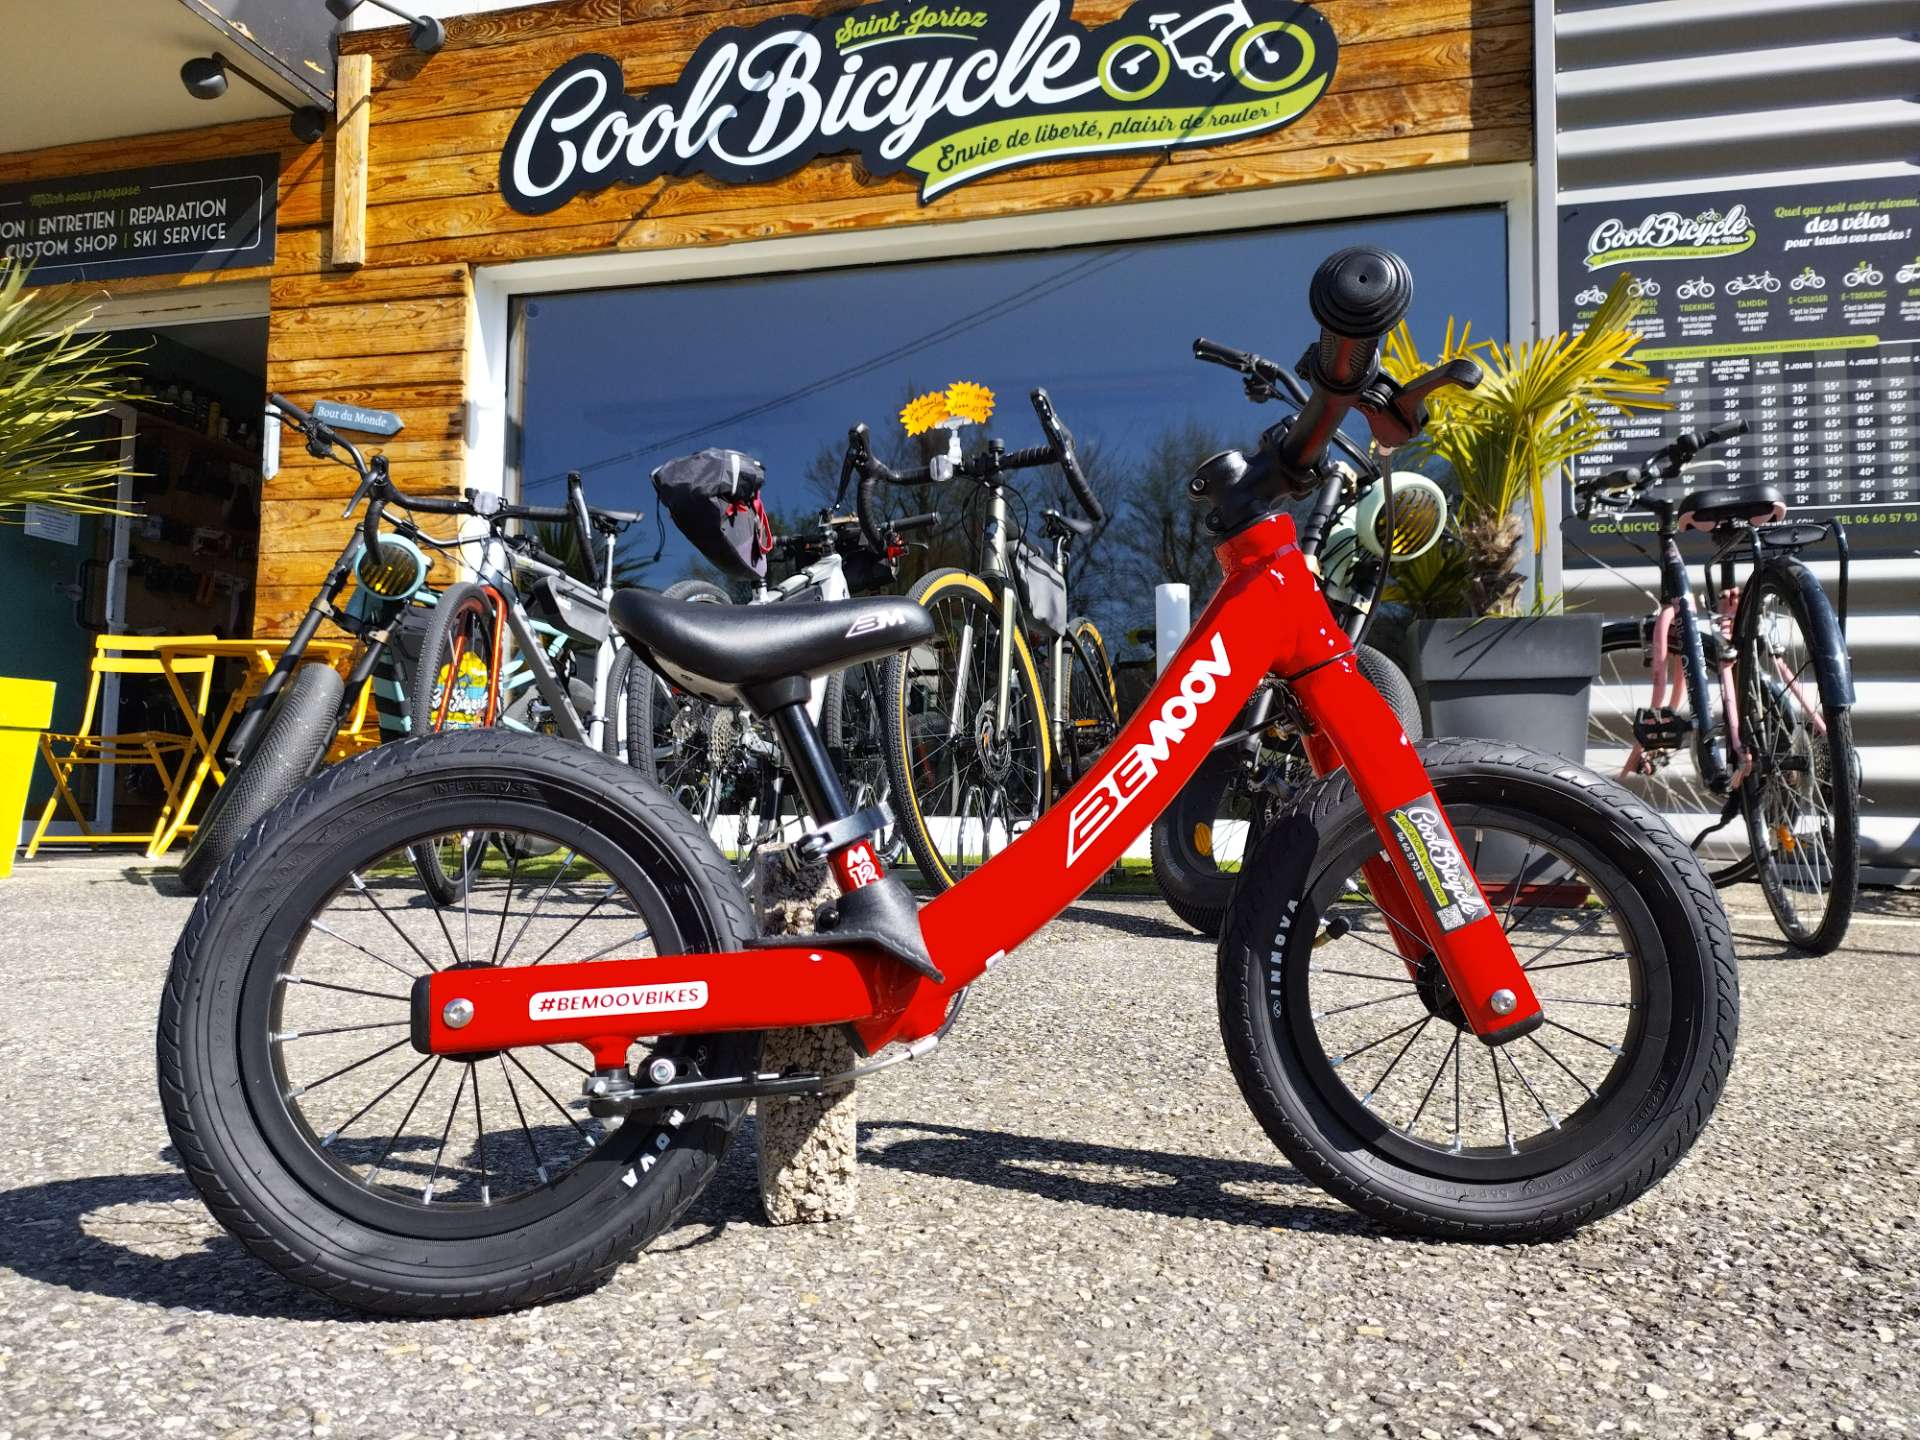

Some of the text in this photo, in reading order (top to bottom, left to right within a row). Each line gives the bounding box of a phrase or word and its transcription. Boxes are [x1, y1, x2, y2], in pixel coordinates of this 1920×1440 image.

[835, 6, 988, 48] Saint-Jorioz
[937, 101, 1281, 173] Envie de liberté, plaisir de rouler !
[38, 210, 115, 235] ENTRETIEN
[129, 198, 227, 226] REPARATION
[1775, 206, 1801, 218] Quel
[1802, 207, 1822, 217] que
[1805, 212, 1890, 233] des vélos
[6, 222, 226, 260] CUSTOM SHOP SKI SERVICE
[1784, 239, 1812, 251] pour
[1814, 235, 1848, 246] toutes
[1849, 233, 1868, 243] vos
[1869, 230, 1904, 242] envies
[1737, 299, 1768, 308] TANDEM
[1788, 294, 1829, 305] E-CRUISER
[1841, 290, 1888, 301] E-TREKKING
[1679, 303, 1715, 312] TREKKING
[318, 407, 387, 427] Bout du Monde
[1620, 428, 1660, 438] TREKKING
[1579, 455, 1613, 464] TANDEM
[1835, 514, 1852, 525] TEL
[1855, 514, 1868, 524] 06
[1872, 513, 1886, 523] 60
[1889, 513, 1902, 523] 57
[1904, 512, 1917, 522] 93
[1066, 632, 1231, 868] BEMOOV
[847, 846, 870, 868] M
[1407, 852, 1416, 861] 57
[1412, 861, 1421, 871] 93
[1270, 899, 1299, 996] INNOVA
[538, 988, 699, 1012] #BEMOOVBIKES
